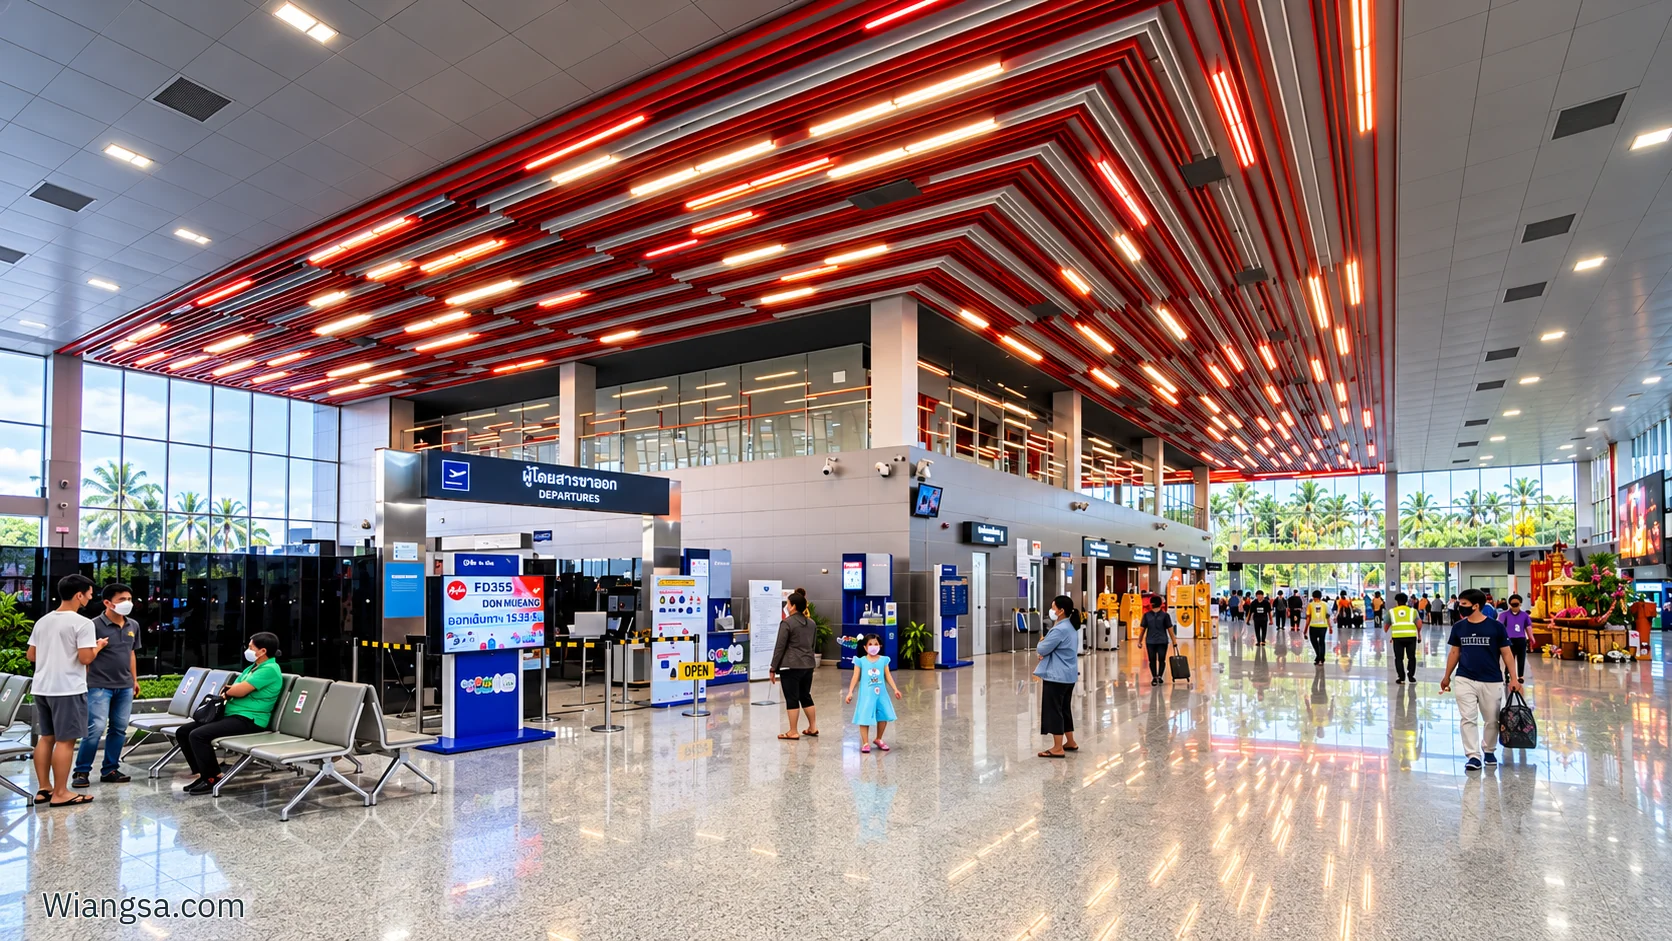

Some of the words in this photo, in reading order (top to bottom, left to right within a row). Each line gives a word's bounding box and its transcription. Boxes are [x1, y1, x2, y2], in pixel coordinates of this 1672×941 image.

[522, 465, 617, 490] ผู้โดยสารขาออก
[539, 490, 600, 503] DEPARTURES
[482, 599, 502, 608] DON
[504, 598, 541, 607] MUEANG
[684, 665, 709, 677] OPEN
